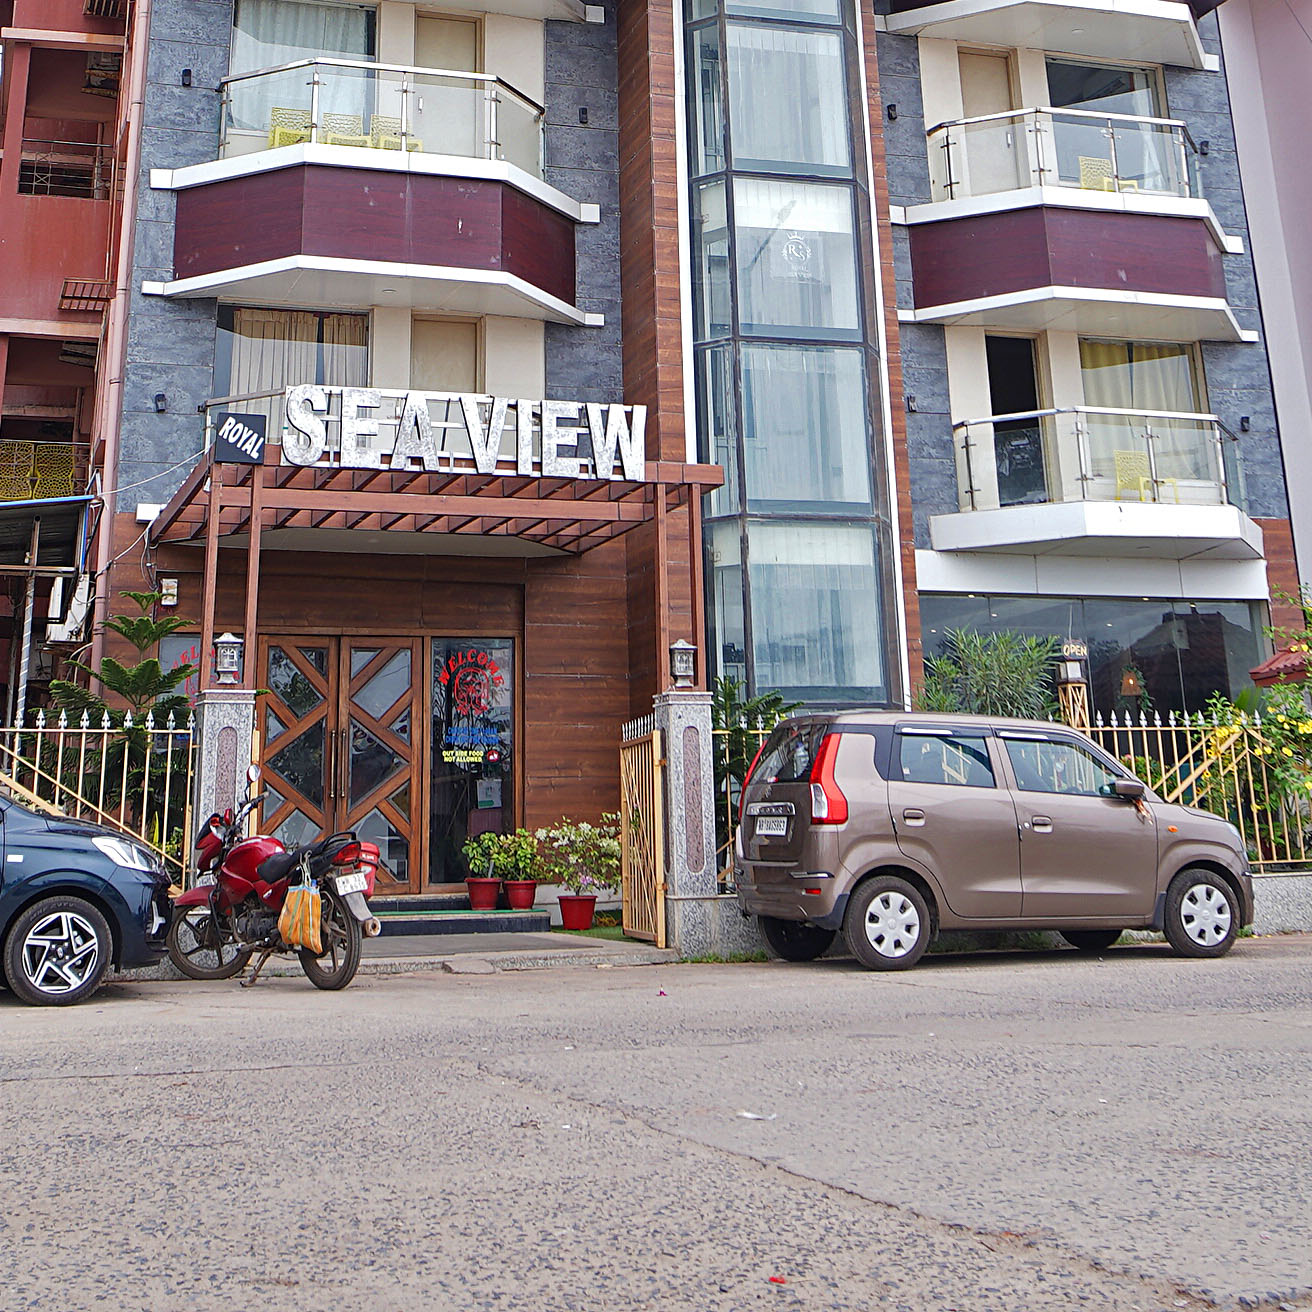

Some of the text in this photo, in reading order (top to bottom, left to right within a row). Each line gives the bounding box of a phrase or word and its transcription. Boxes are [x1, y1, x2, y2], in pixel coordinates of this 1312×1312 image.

[218, 416, 265, 460] ROYAL
[438, 649, 505, 688] WELCOME
[1063, 644, 1087, 657] OPEN
